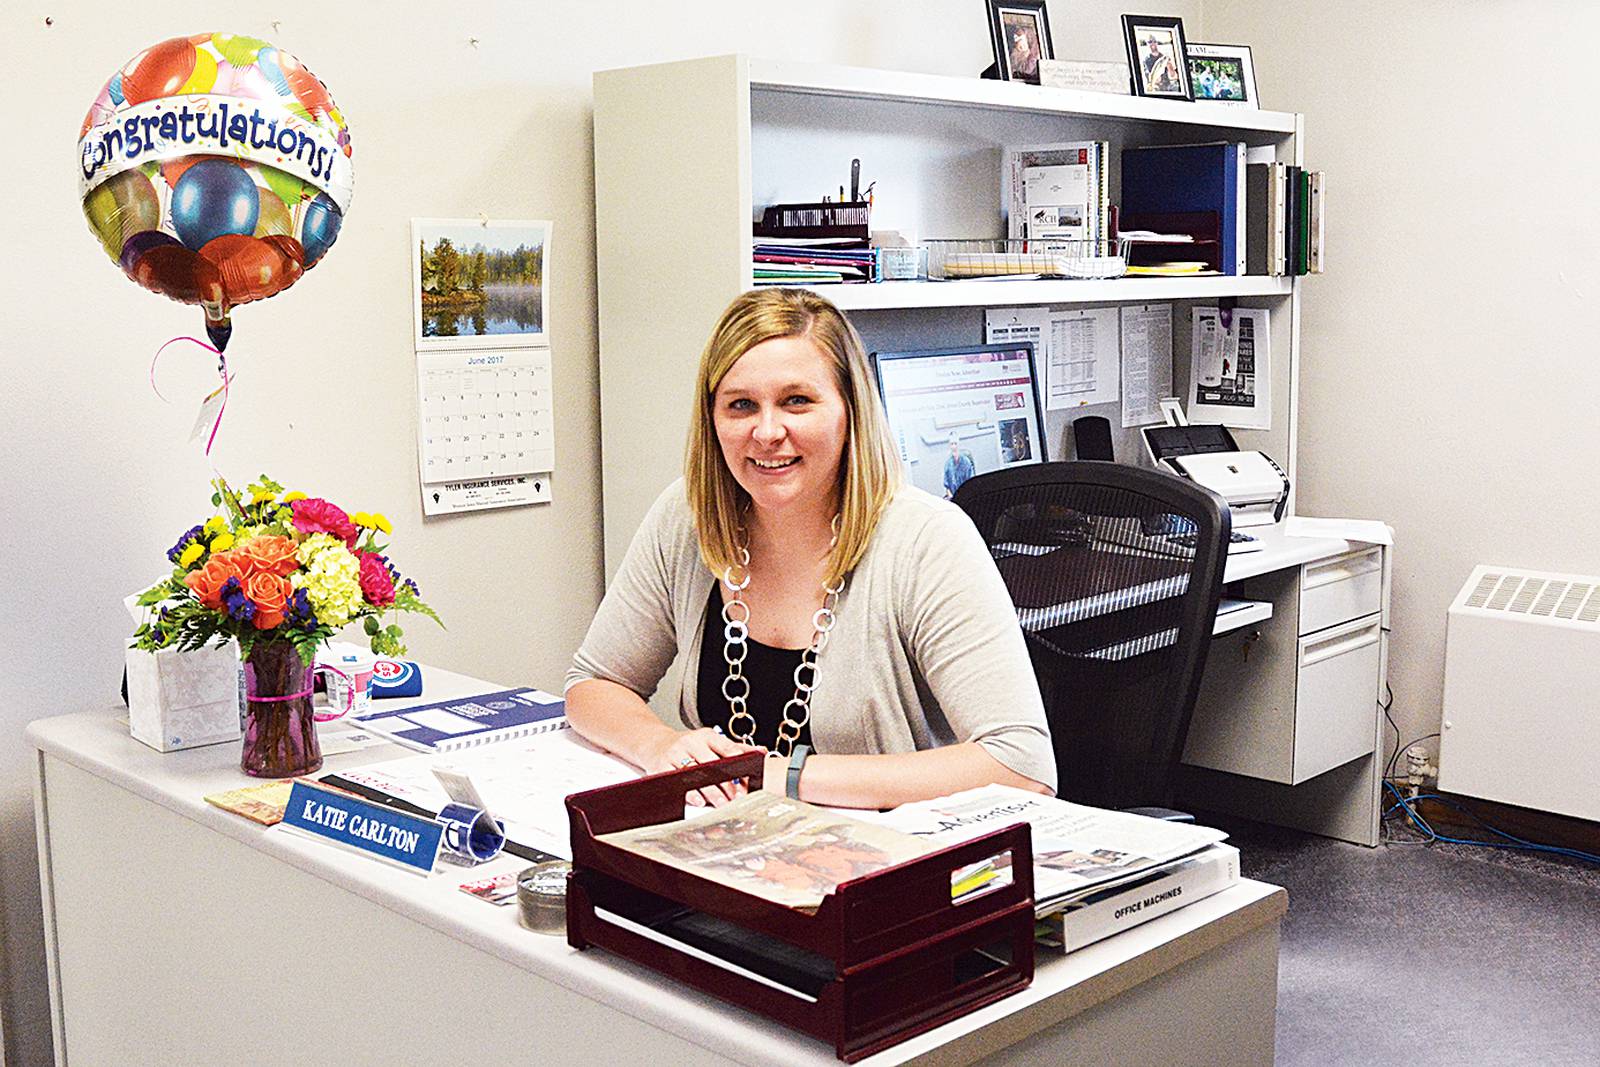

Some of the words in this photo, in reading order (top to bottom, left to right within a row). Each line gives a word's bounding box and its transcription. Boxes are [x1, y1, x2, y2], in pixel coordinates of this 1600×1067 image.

[81, 103, 338, 182] Congratulations!
[468, 357, 486, 365] June
[487, 356, 504, 364] 2017
[462, 481, 490, 490] INSURANCE
[302, 800, 348, 831] KATIE
[349, 815, 420, 854] CARLTON
[1114, 902, 1142, 919] OFFICE
[1143, 887, 1182, 908] MACHINES
